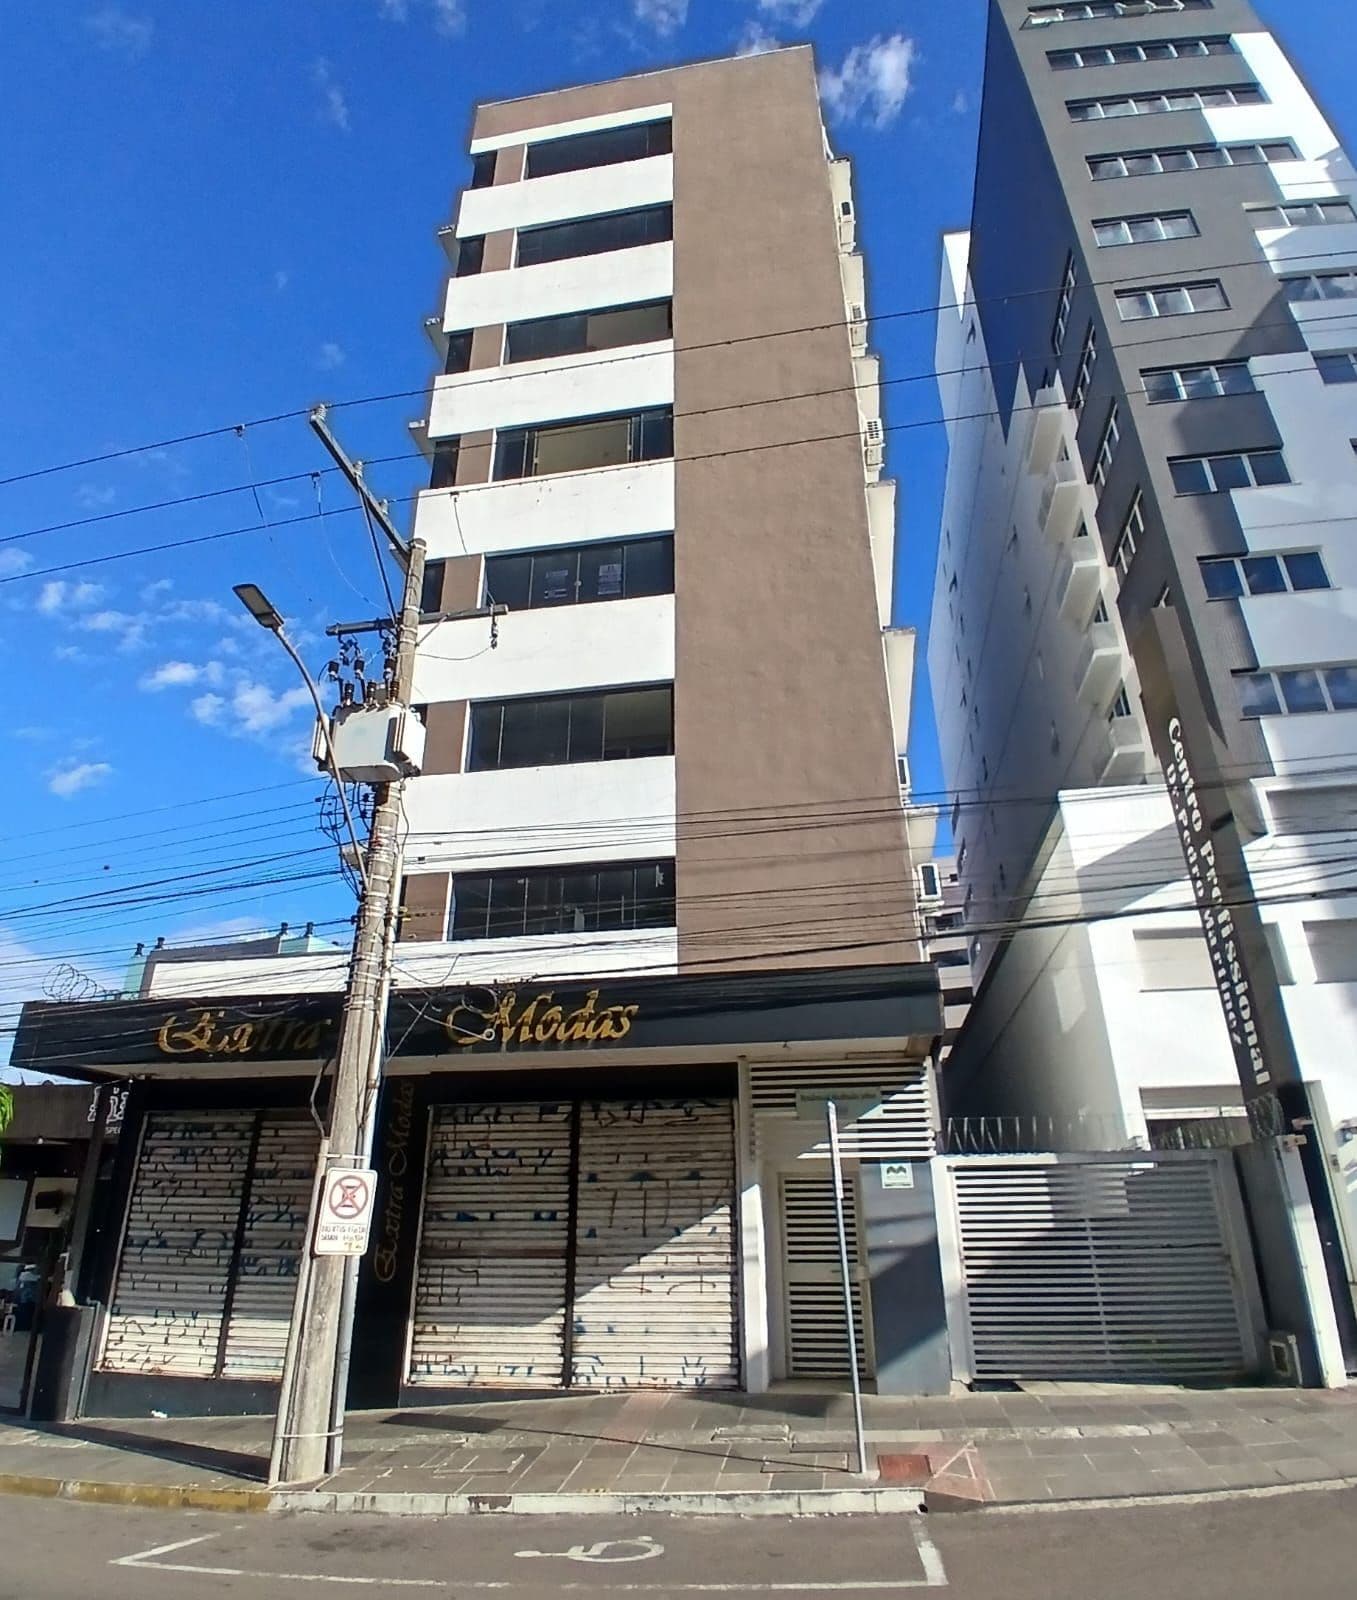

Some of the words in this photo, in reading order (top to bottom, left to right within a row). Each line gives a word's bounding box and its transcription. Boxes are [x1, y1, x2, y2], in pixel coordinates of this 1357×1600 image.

[1167, 717, 1203, 833] Centro
[1200, 839, 1272, 1088] Profissional
[447, 988, 640, 1045] Modas
[385, 1080, 416, 1178] Modas
[374, 1181, 404, 1283] Extra
